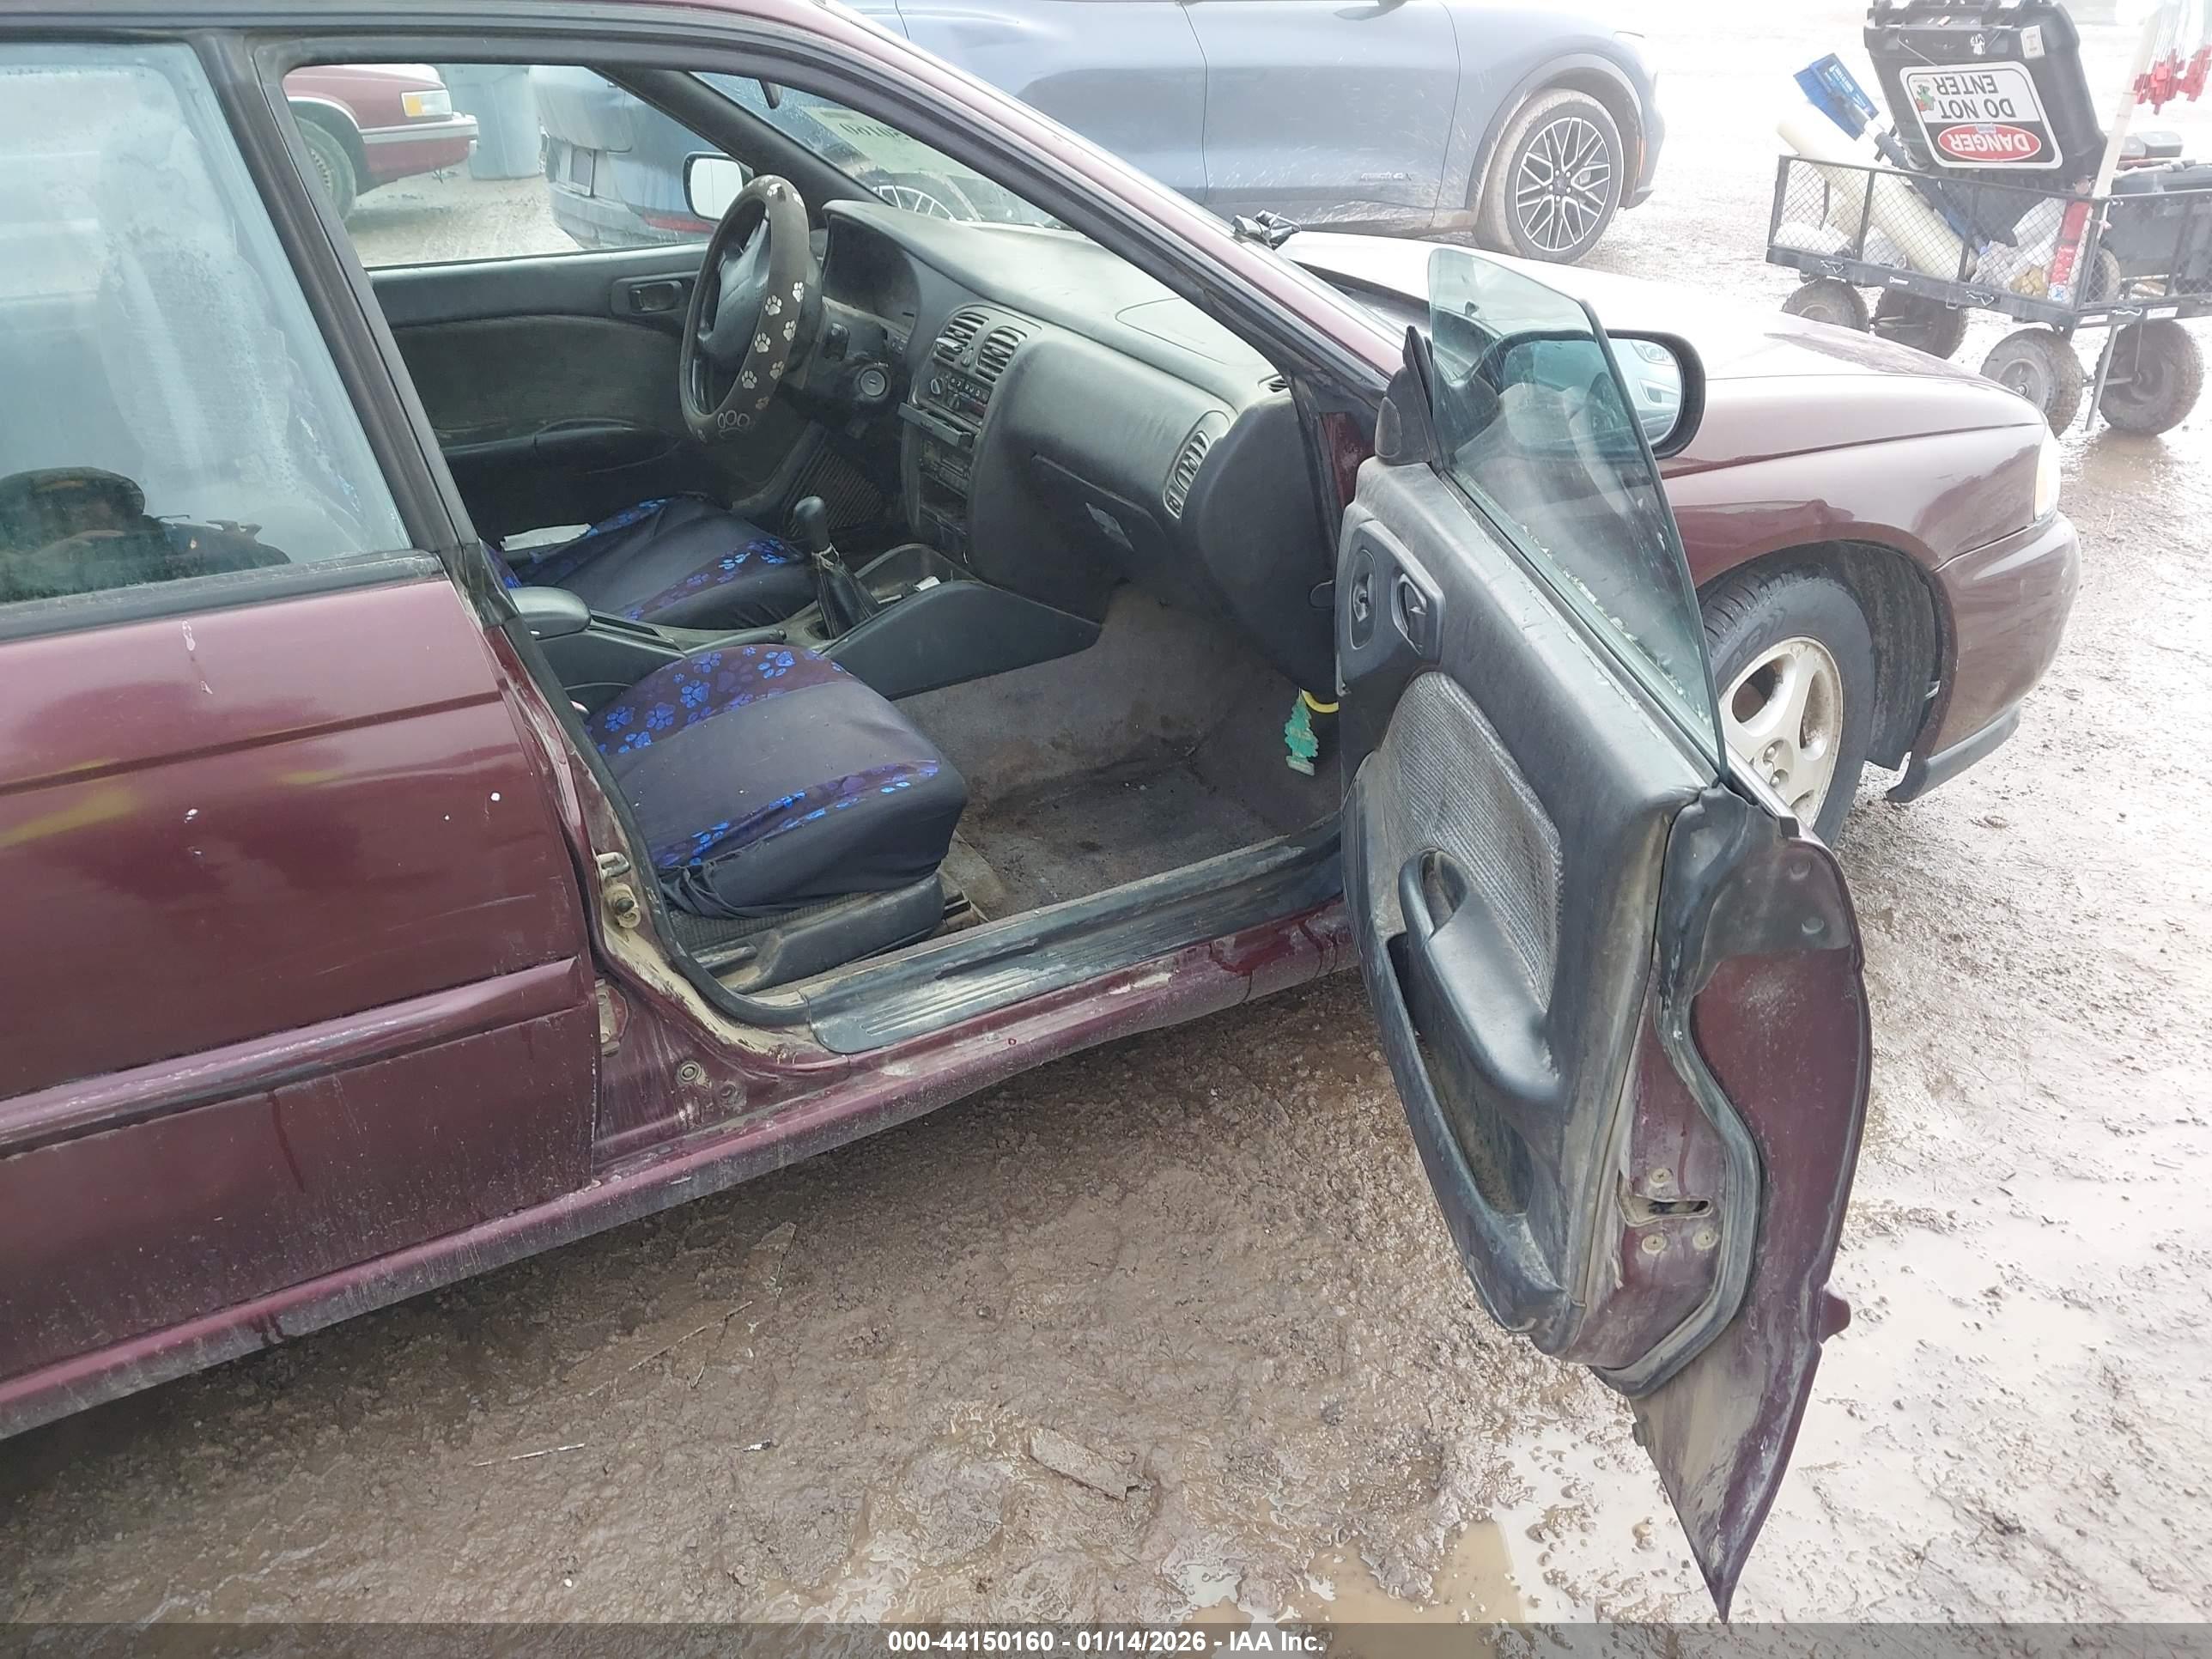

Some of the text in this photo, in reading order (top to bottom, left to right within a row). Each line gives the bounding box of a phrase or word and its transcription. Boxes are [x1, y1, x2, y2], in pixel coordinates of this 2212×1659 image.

[1932, 75, 1999, 95] ENTER
[1938, 98, 2017, 119] DO NOT
[1947, 133, 2031, 152] DANGER
